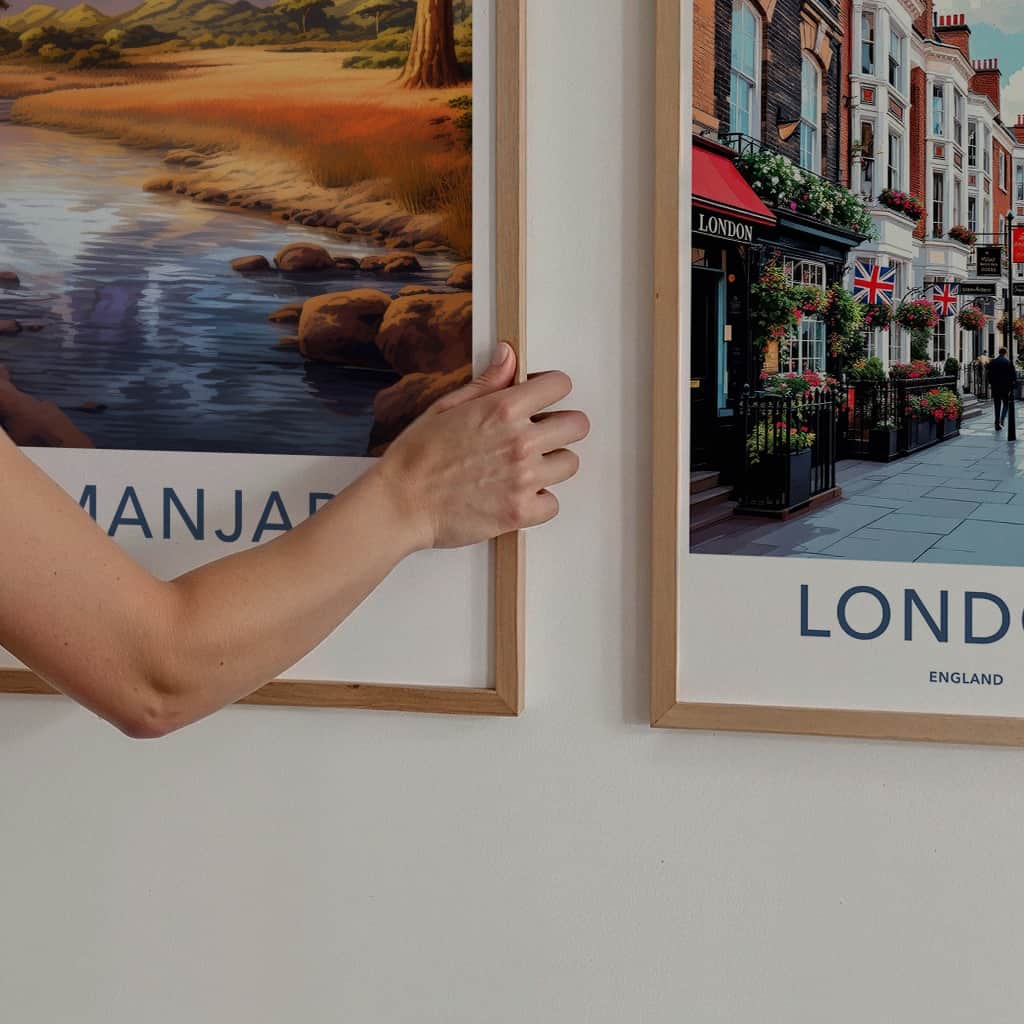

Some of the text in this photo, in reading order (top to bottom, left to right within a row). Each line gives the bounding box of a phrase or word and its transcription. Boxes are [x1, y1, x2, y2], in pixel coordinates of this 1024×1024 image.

[698, 213, 753, 242] LONDON
[800, 583, 1024, 645] LOND
[929, 671, 1004, 686] ENGLAND
